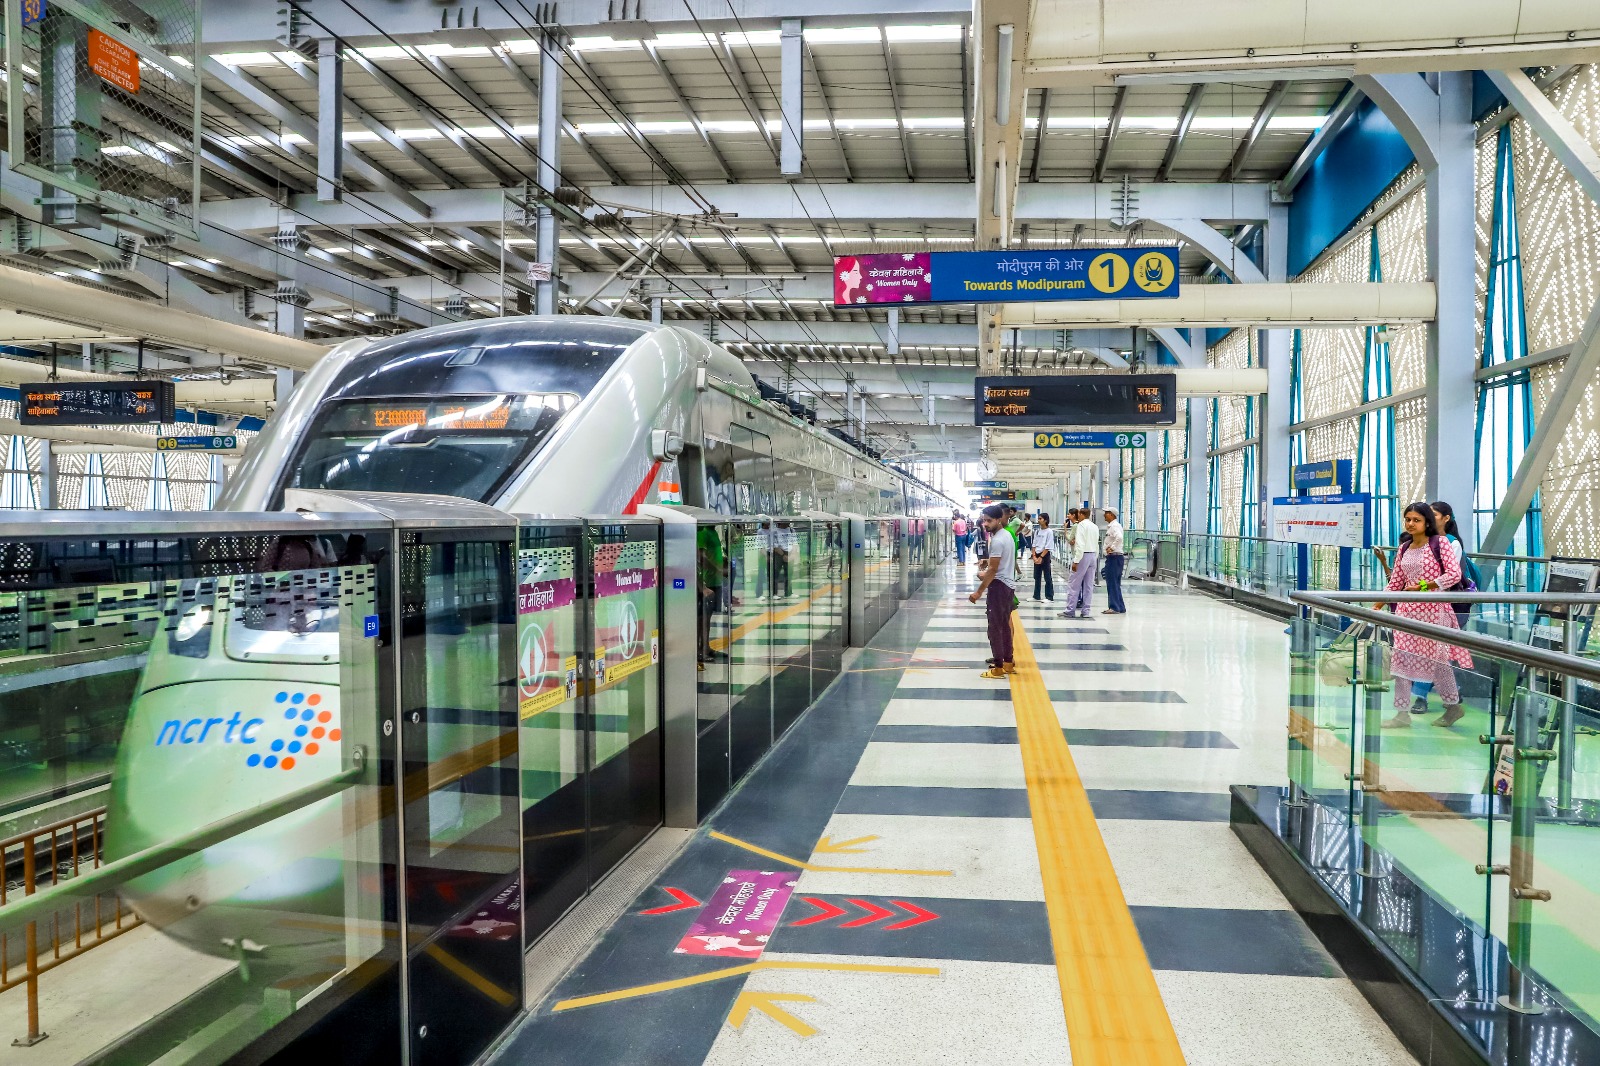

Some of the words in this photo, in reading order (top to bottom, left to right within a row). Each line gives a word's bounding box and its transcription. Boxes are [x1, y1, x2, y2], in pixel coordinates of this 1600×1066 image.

[99, 35, 131, 58] CAUTION
[99, 44, 130, 65] CLEARANCE
[111, 57, 119, 66] TO
[94, 63, 134, 90] RESTRICTED
[868, 268, 892, 278] केवल
[996, 258, 1042, 274] मोदीपुरम
[1045, 257, 1060, 271] की
[1064, 258, 1083, 271] ओर
[1099, 258, 1115, 288] 1
[875, 279, 901, 287] Women
[901, 279, 918, 288] Only
[964, 279, 1013, 292] Towards
[1016, 278, 1085, 292] Modipuram
[1137, 403, 1161, 413] 11:56
[615, 573, 632, 587] Women
[632, 571, 643, 588] Only
[367, 621, 376, 631] E9
[155, 711, 264, 746] ncrtc
[744, 900, 768, 921] Women
[757, 887, 779, 901] Only
